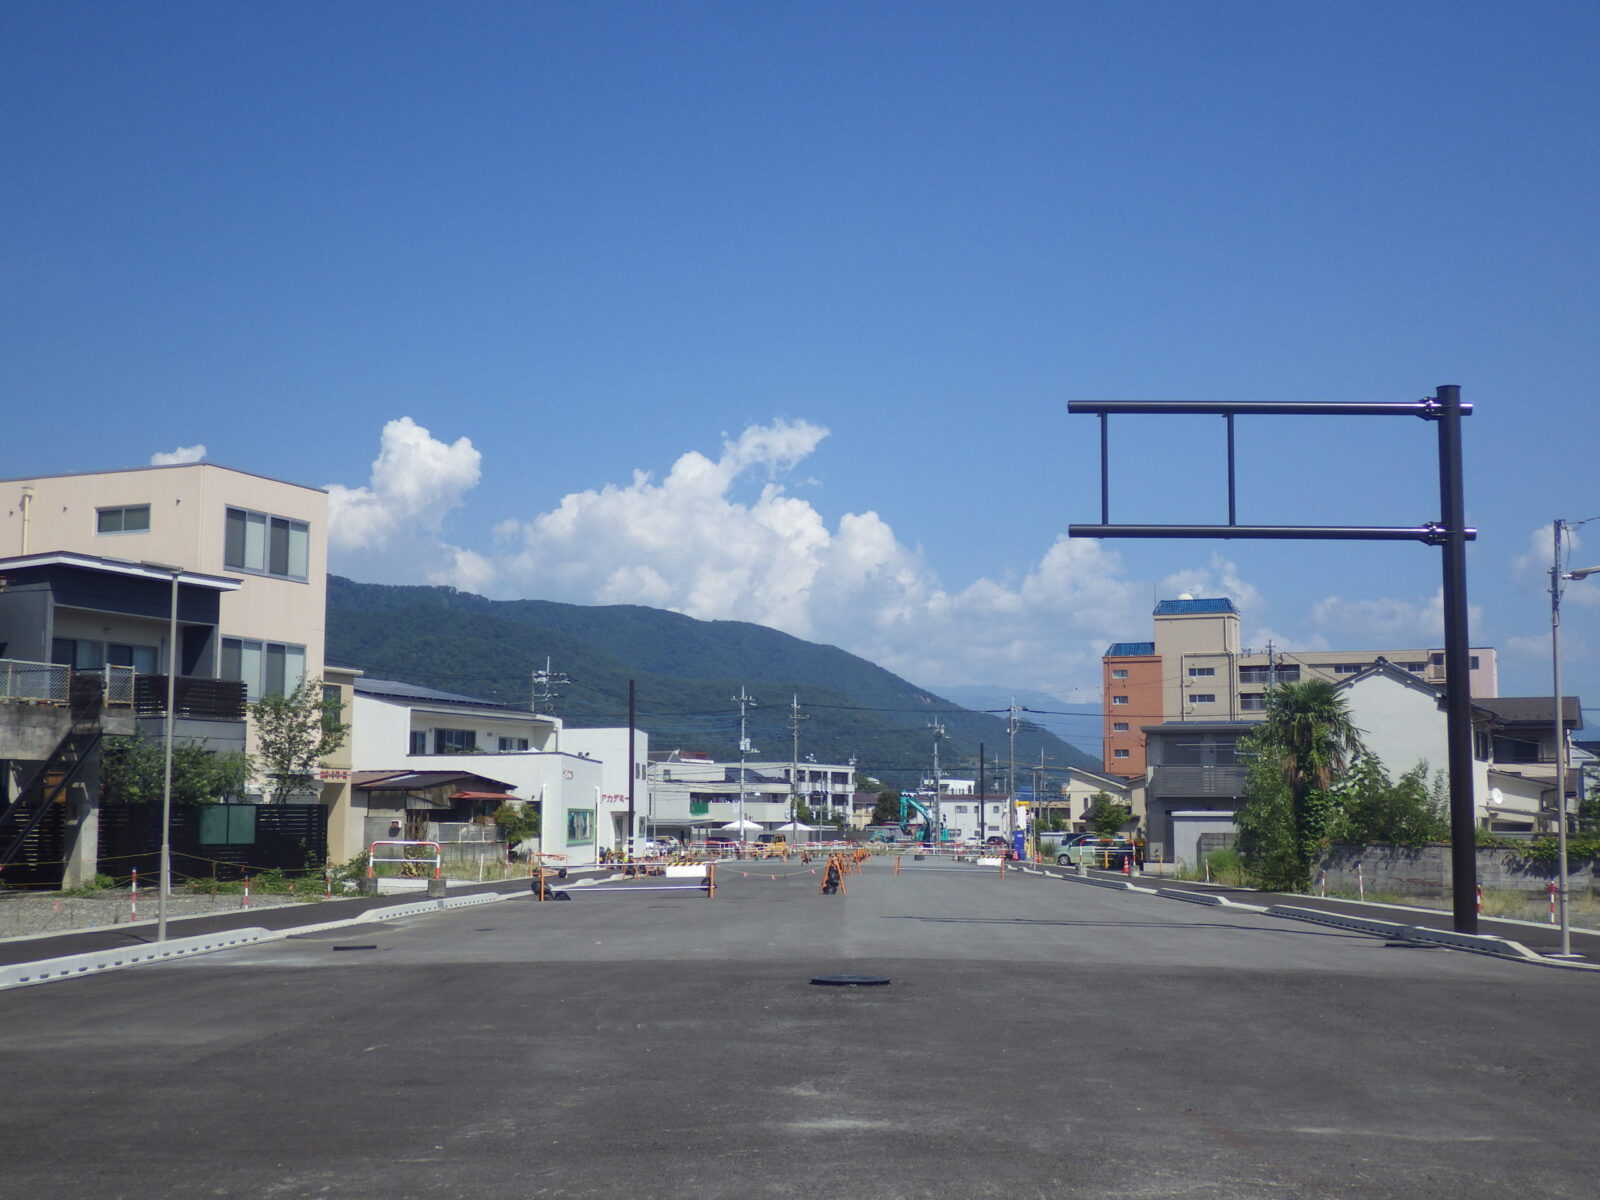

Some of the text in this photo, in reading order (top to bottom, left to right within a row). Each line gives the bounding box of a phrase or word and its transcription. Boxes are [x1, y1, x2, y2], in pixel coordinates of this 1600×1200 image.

[600, 794, 629, 804] アカデミー
